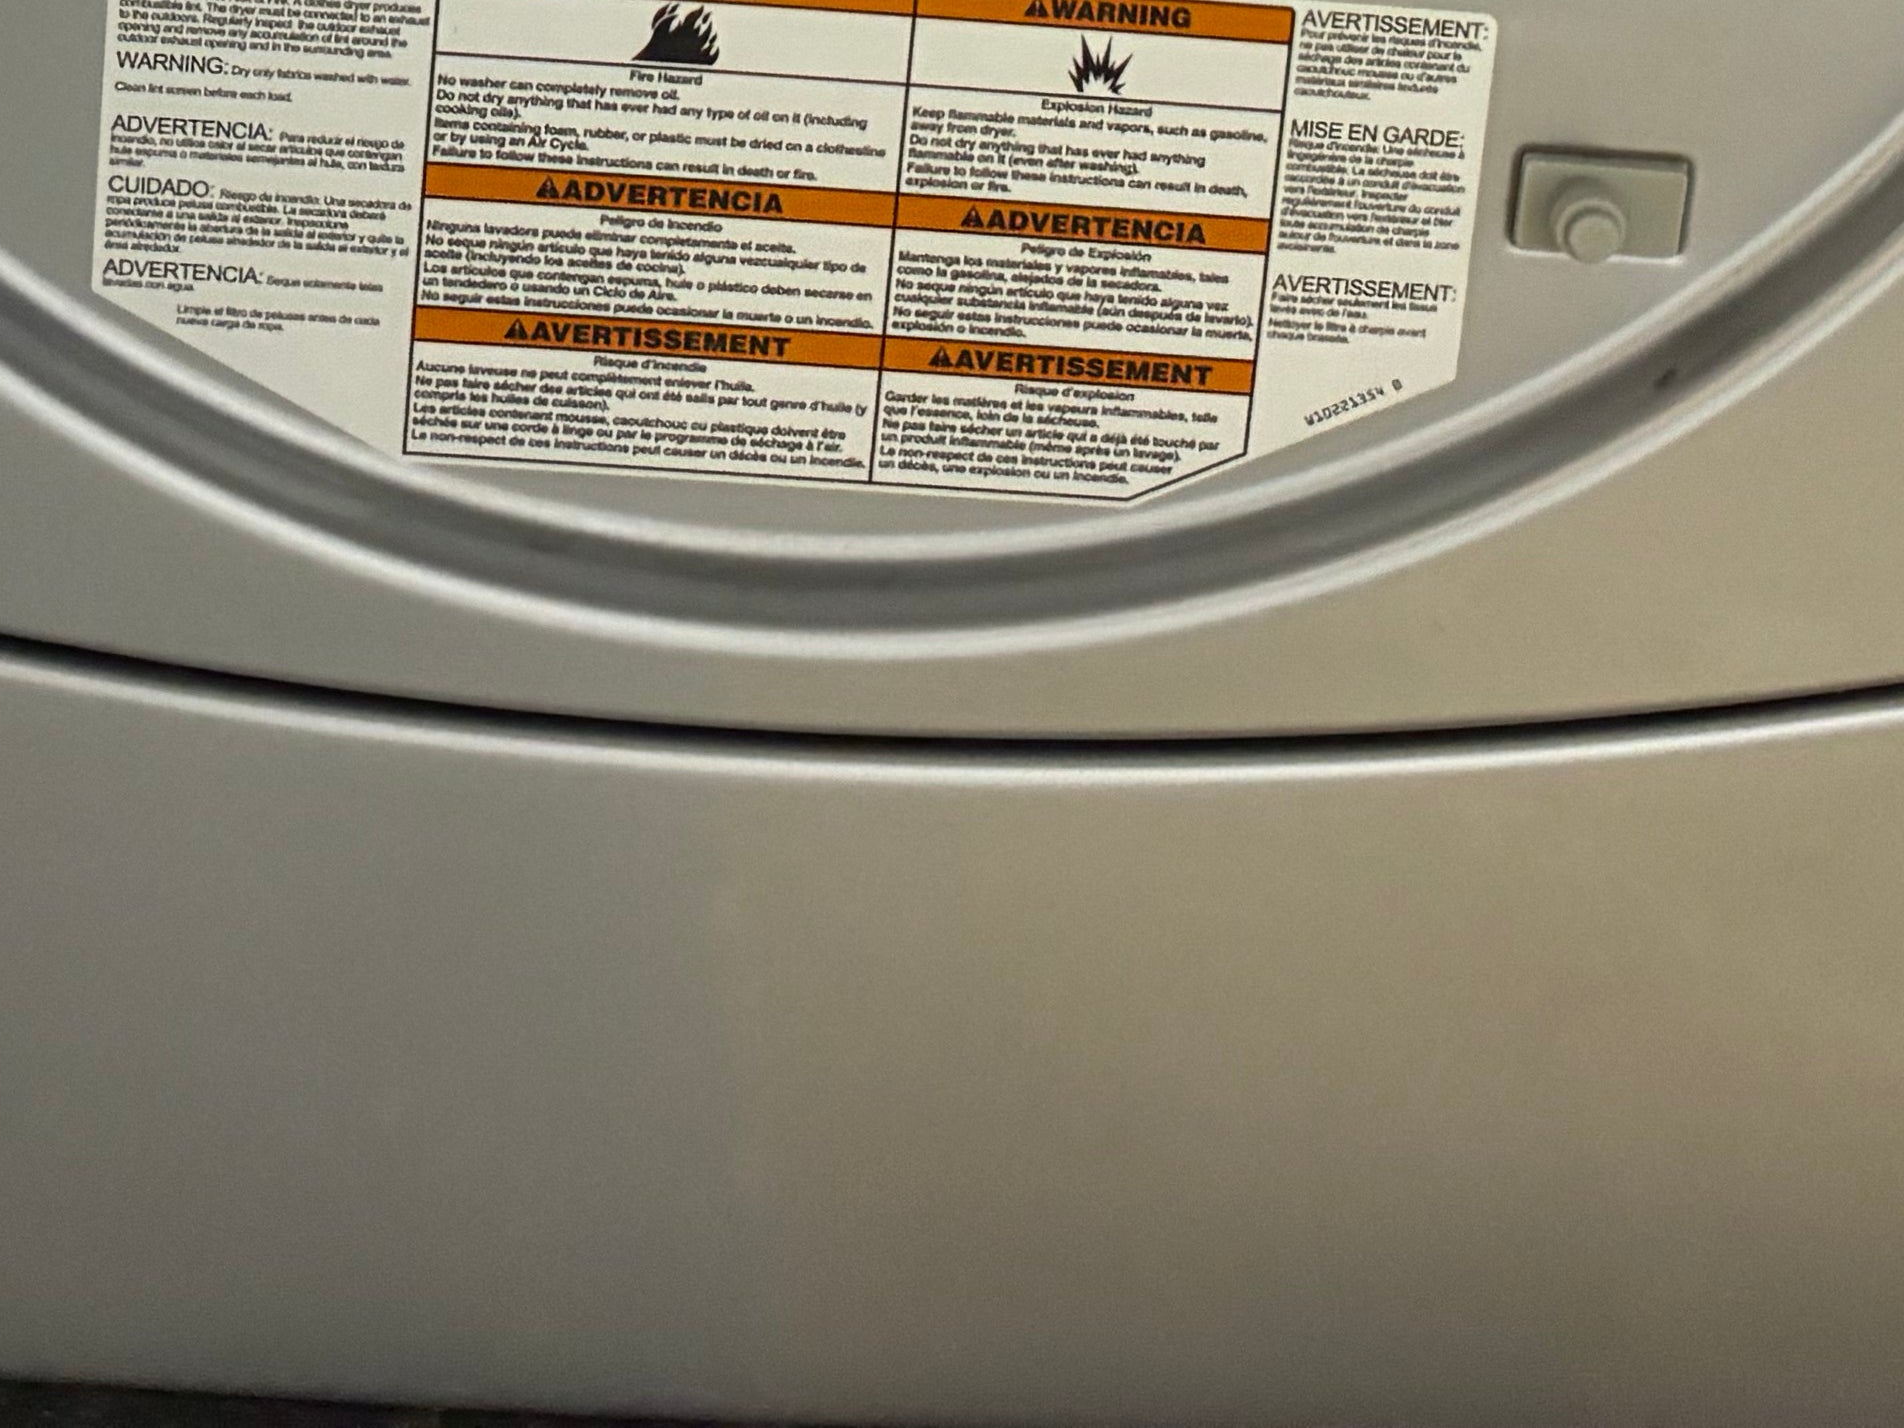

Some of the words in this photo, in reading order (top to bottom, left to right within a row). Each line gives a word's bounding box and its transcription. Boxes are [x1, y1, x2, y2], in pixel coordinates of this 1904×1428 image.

[1301, 9, 1488, 39] AVERTISSEMENT:
[116, 50, 229, 75] WARNING:
[437, 73, 457, 87] No
[459, 76, 508, 89] washer
[509, 80, 534, 91] can
[535, 82, 607, 99] completely
[609, 87, 659, 100] remove
[660, 89, 680, 101] oil.
[629, 69, 655, 83] Fire
[657, 71, 703, 86] Hazard
[434, 103, 488, 120] cooking
[490, 105, 522, 121] oils).
[436, 88, 456, 102] Do
[457, 91, 480, 103] not
[482, 92, 505, 108] dry
[506, 94, 564, 111] anything
[566, 97, 592, 110] that
[594, 99, 619, 112] has
[620, 103, 650, 114] ever
[652, 103, 678, 116] had
[679, 107, 704, 120] any
[706, 107, 735, 121] type
[736, 109, 752, 121] of
[752, 110, 770, 122] oil
[771, 113, 790, 124] on
[791, 112, 801, 124] it
[110, 114, 273, 141] ADVERTENCIA:
[432, 132, 448, 142] or
[449, 131, 467, 146] by
[469, 134, 507, 149] using
[508, 137, 526, 147] an
[527, 135, 548, 149] Air
[549, 137, 589, 153] Cycle.
[472, 121, 542, 138] containing
[543, 123, 581, 140] foam,
[583, 127, 630, 142] rubber,
[631, 132, 647, 142] or
[648, 131, 692, 145] plastic
[694, 136, 728, 147] must
[730, 136, 747, 149] be
[748, 138, 783, 151] dried
[785, 142, 803, 152] on
[804, 143, 814, 153] a
[815, 142, 887, 158] clothesline
[1290, 118, 1344, 140] MISE
[1348, 123, 1378, 143] EN
[1383, 125, 1465, 149] GARDE:
[432, 144, 477, 159] Failure
[479, 148, 493, 160] to
[495, 149, 535, 163] follow
[537, 152, 574, 165] these
[576, 154, 653, 171] instructions
[655, 161, 680, 172] can
[682, 163, 720, 175] result
[722, 163, 735, 176] in
[736, 165, 774, 178] death
[775, 169, 791, 180] or
[793, 168, 818, 181] fire.
[107, 174, 214, 199] CUIDADO:
[561, 179, 783, 214] ADVERTENCIA
[986, 209, 1206, 245] ADVERTENCIA
[102, 258, 263, 285] ADVERTENCIA:
[1272, 273, 1456, 302] AVERTISSEMENT:
[530, 321, 791, 357] AVERTISSEMENT
[954, 349, 1213, 386] AVERTISSEMENT
